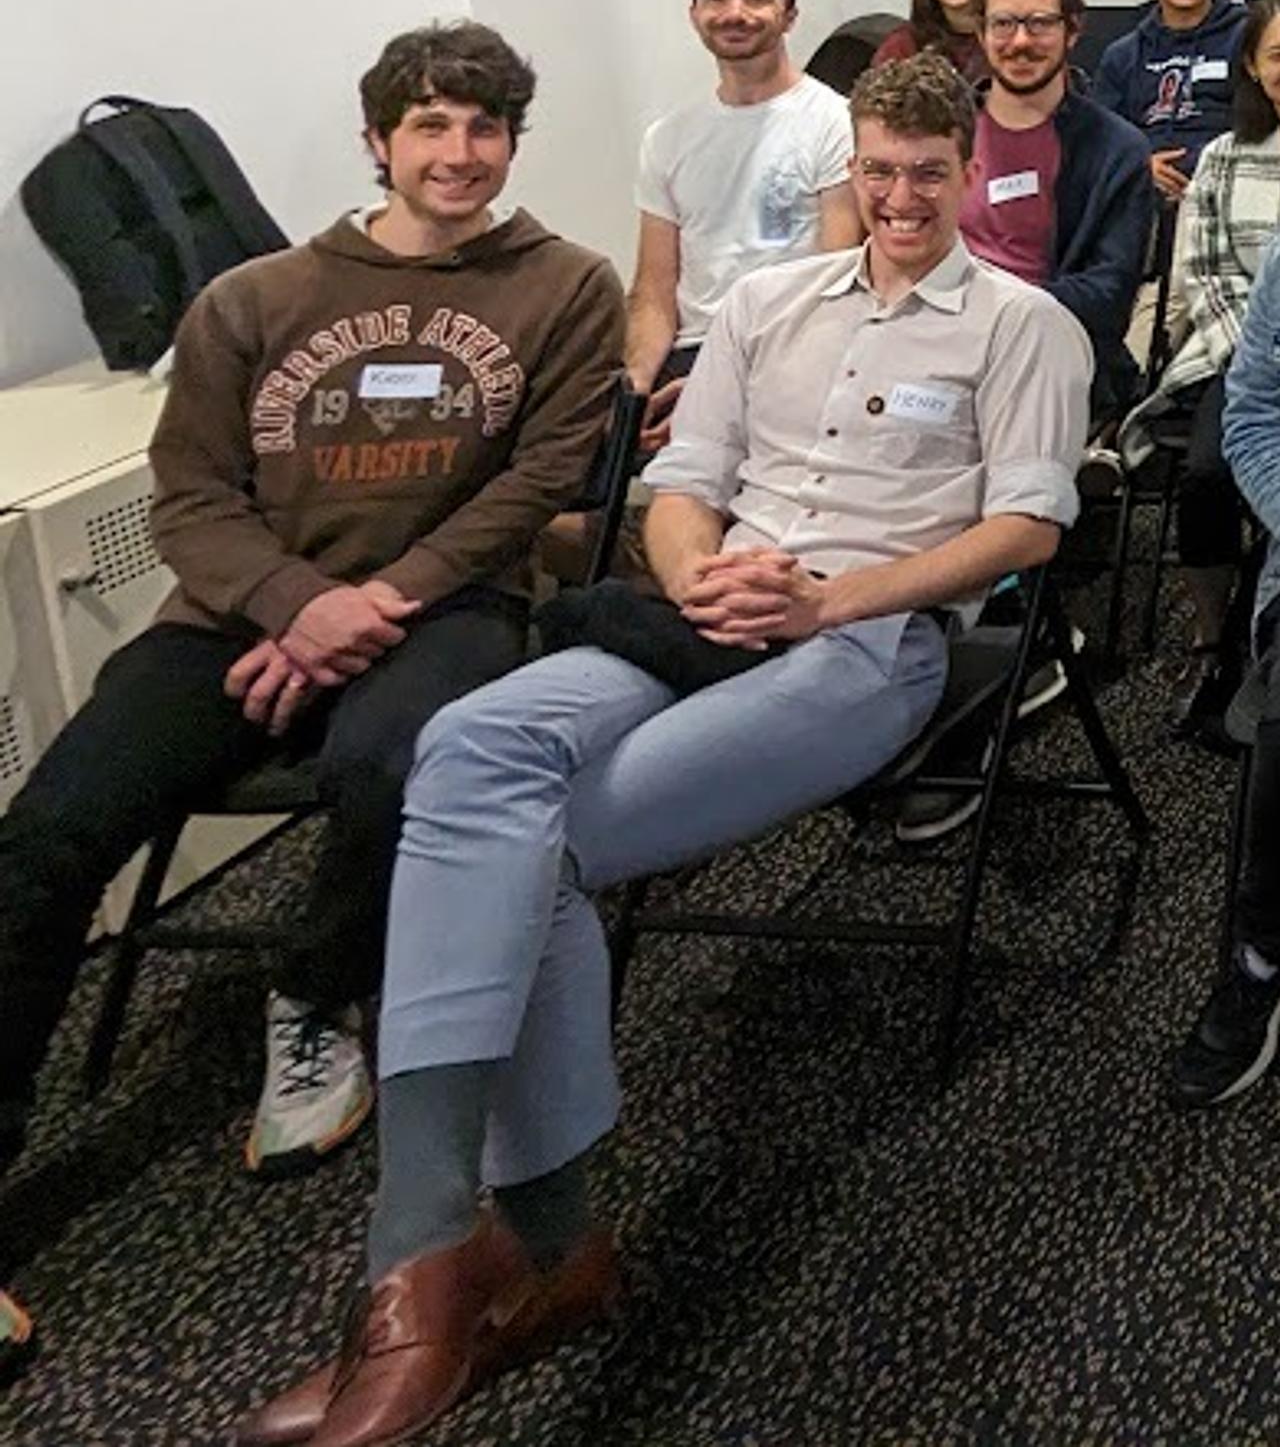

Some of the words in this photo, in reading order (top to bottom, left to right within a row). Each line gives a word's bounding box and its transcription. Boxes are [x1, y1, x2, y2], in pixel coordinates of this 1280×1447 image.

[252, 305, 412, 454] RIVERSIDE
[311, 388, 349, 426] 19
[313, 437, 462, 481] VARSITY
